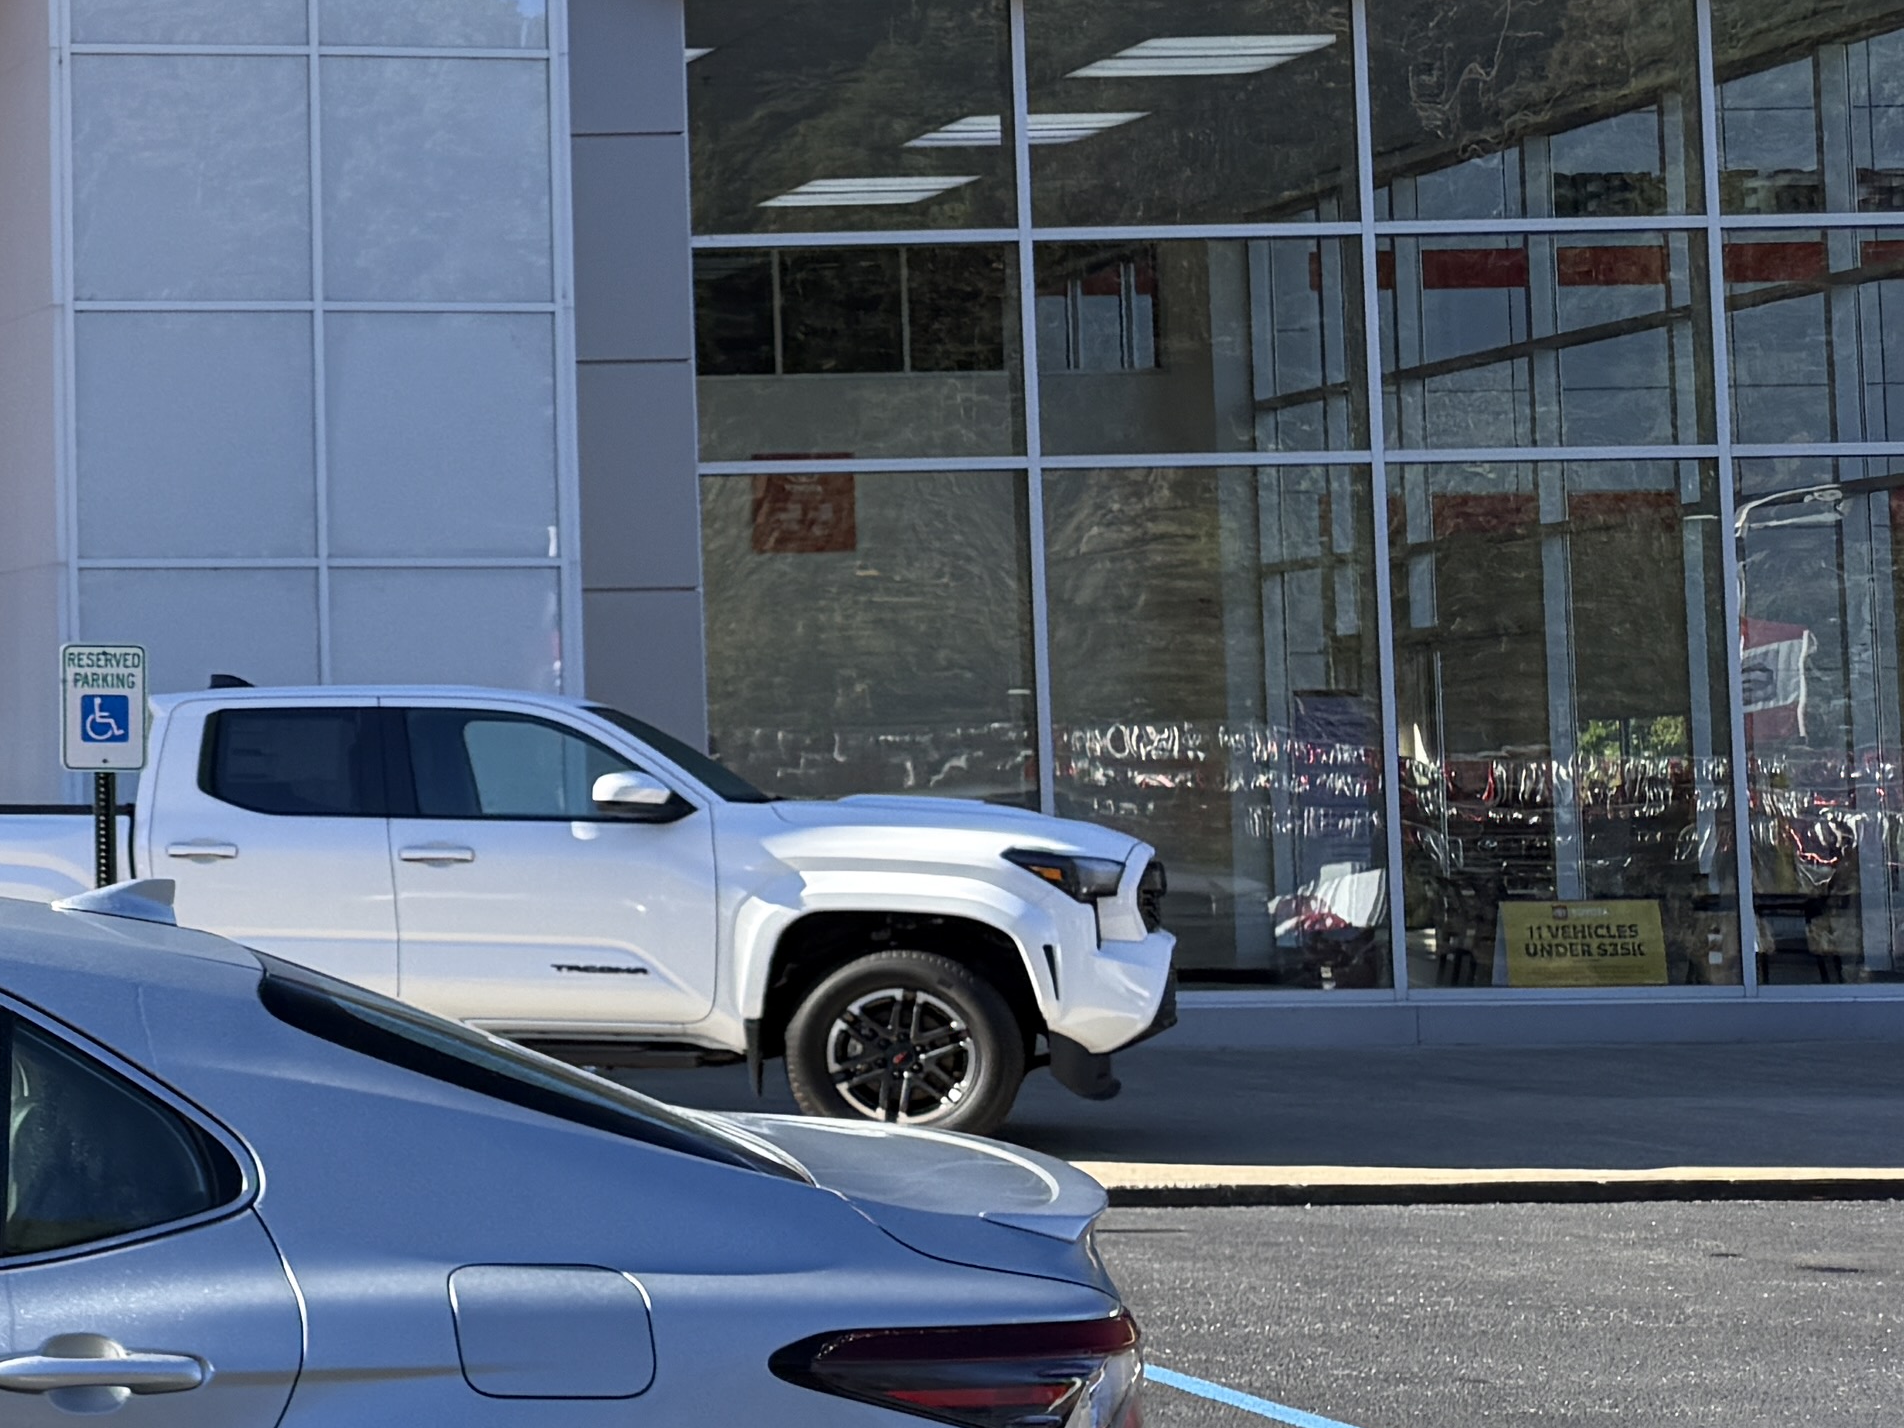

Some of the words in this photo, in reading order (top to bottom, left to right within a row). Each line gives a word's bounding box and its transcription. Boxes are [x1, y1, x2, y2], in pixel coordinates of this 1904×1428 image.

[67, 651, 141, 668] RESERVED
[73, 672, 136, 689] PARKING
[1528, 925, 1543, 940] 11
[1545, 924, 1639, 940] VEHICLES
[1525, 942, 1594, 958] UNDER
[550, 963, 649, 975] TACOMA
